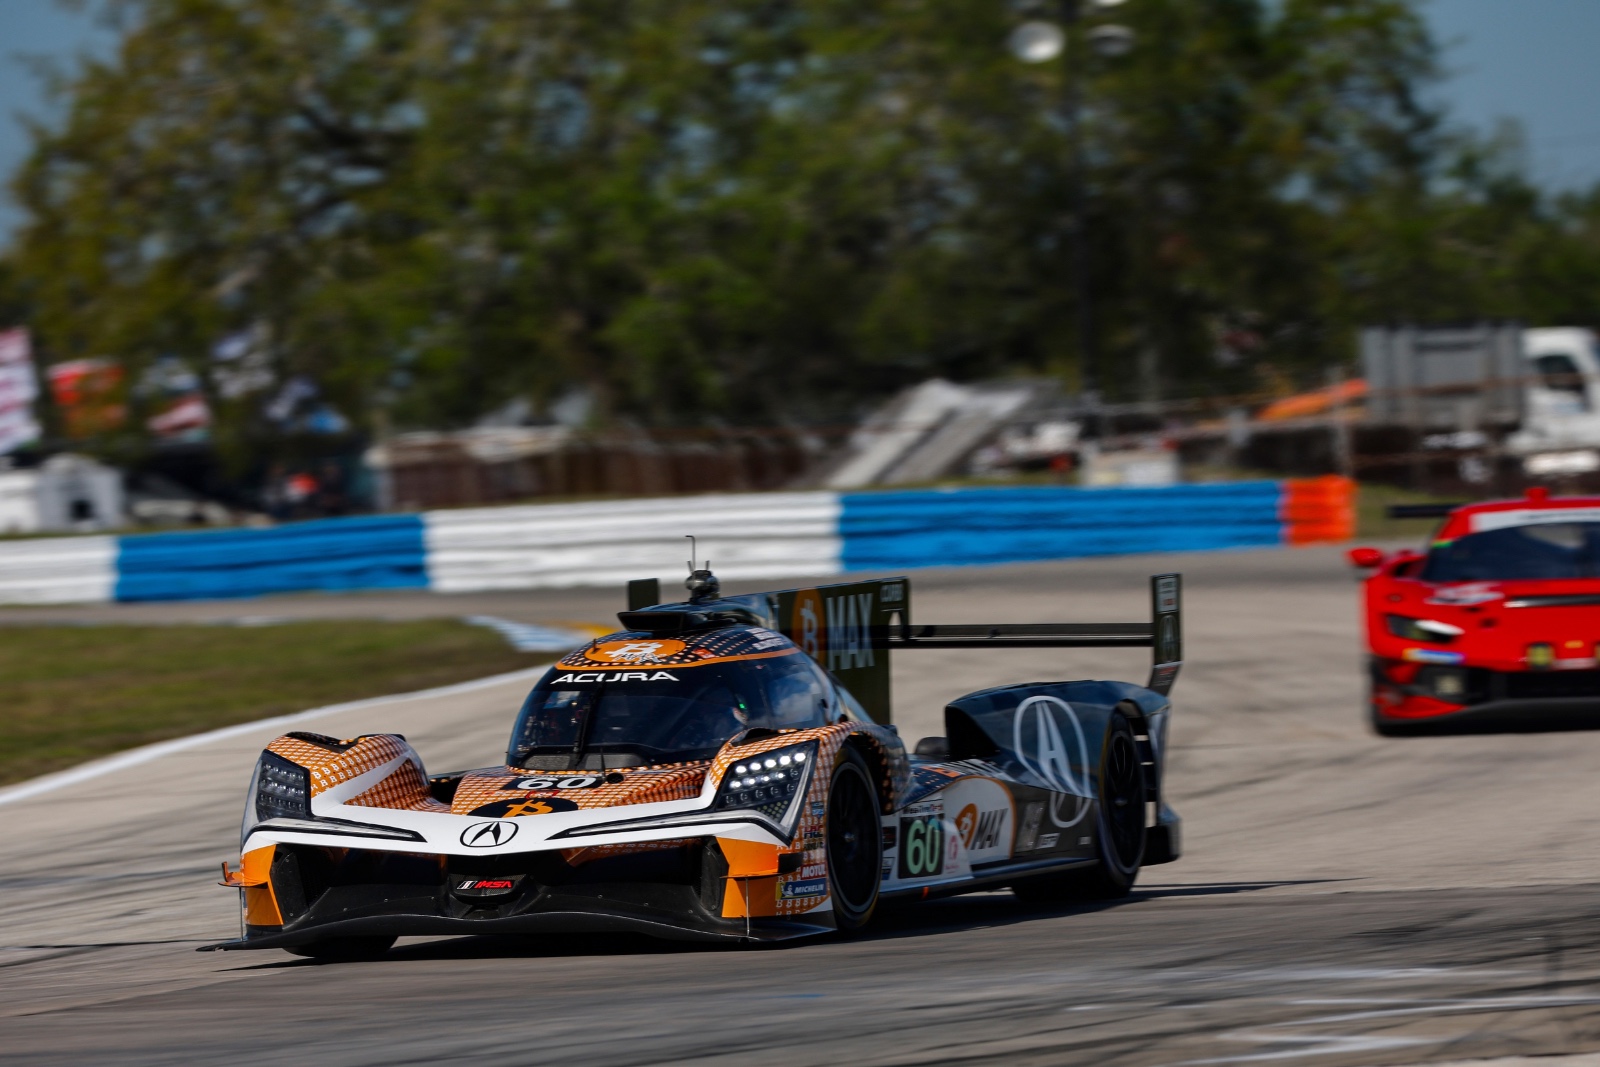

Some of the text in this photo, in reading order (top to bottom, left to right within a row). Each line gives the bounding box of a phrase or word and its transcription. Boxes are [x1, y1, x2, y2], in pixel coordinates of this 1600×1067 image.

[825, 593, 876, 672] MAX
[550, 671, 680, 685] ACURA
[516, 777, 597, 790] 60
[970, 807, 1010, 851] MAX
[906, 818, 941, 875] 60
[801, 863, 827, 879] MOTUL
[473, 879, 513, 889] IMSA
[794, 883, 825, 894] MICHELIN
